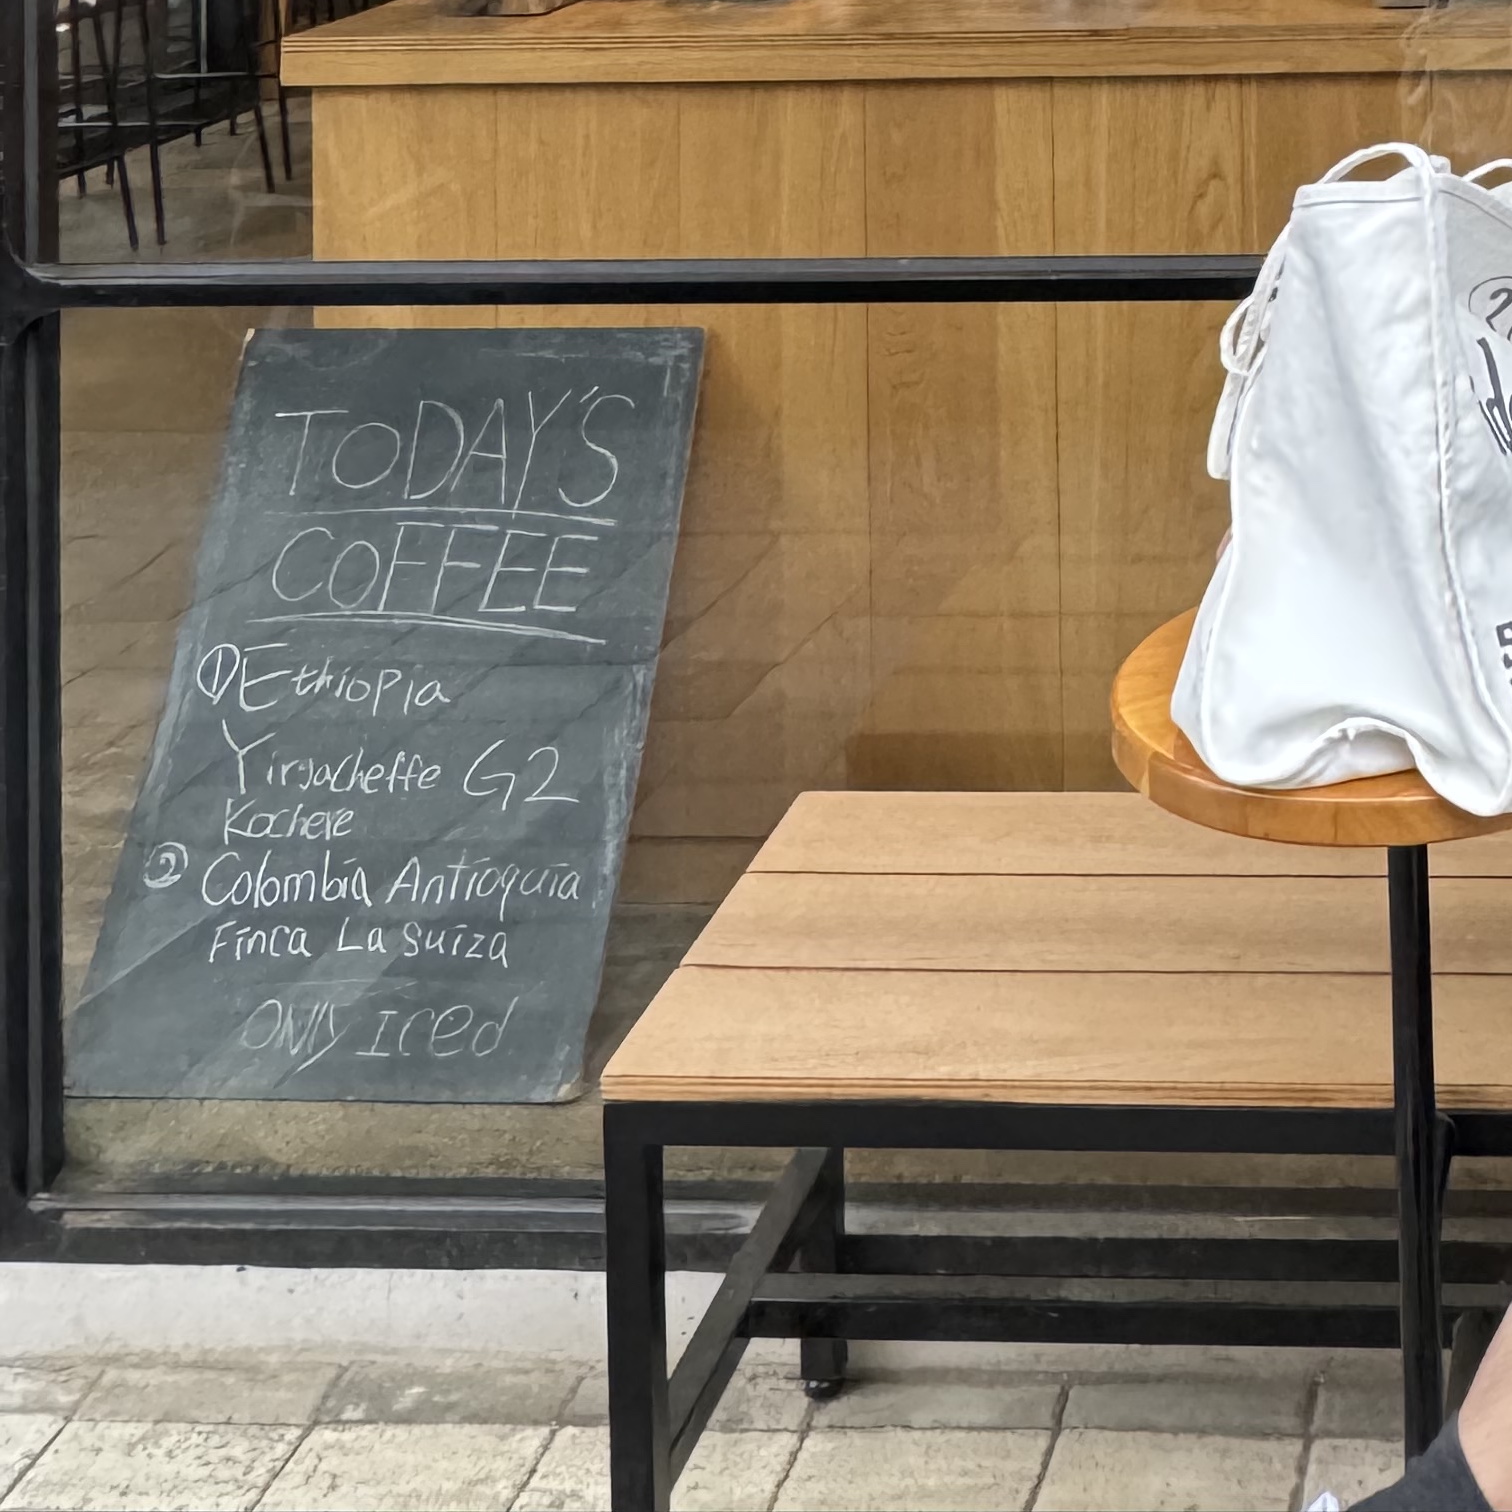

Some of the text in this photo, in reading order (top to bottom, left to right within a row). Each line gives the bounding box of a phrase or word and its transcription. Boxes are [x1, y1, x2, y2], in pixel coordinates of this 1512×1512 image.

[275, 386, 635, 519] TODAY'S
[272, 522, 599, 612] COFFEE
[239, 642, 451, 717] Ethiopia
[463, 739, 579, 810] G2
[202, 849, 373, 908] Colombia
[385, 848, 581, 922] Antioquia
[209, 920, 312, 963] Finca
[337, 916, 387, 954] La
